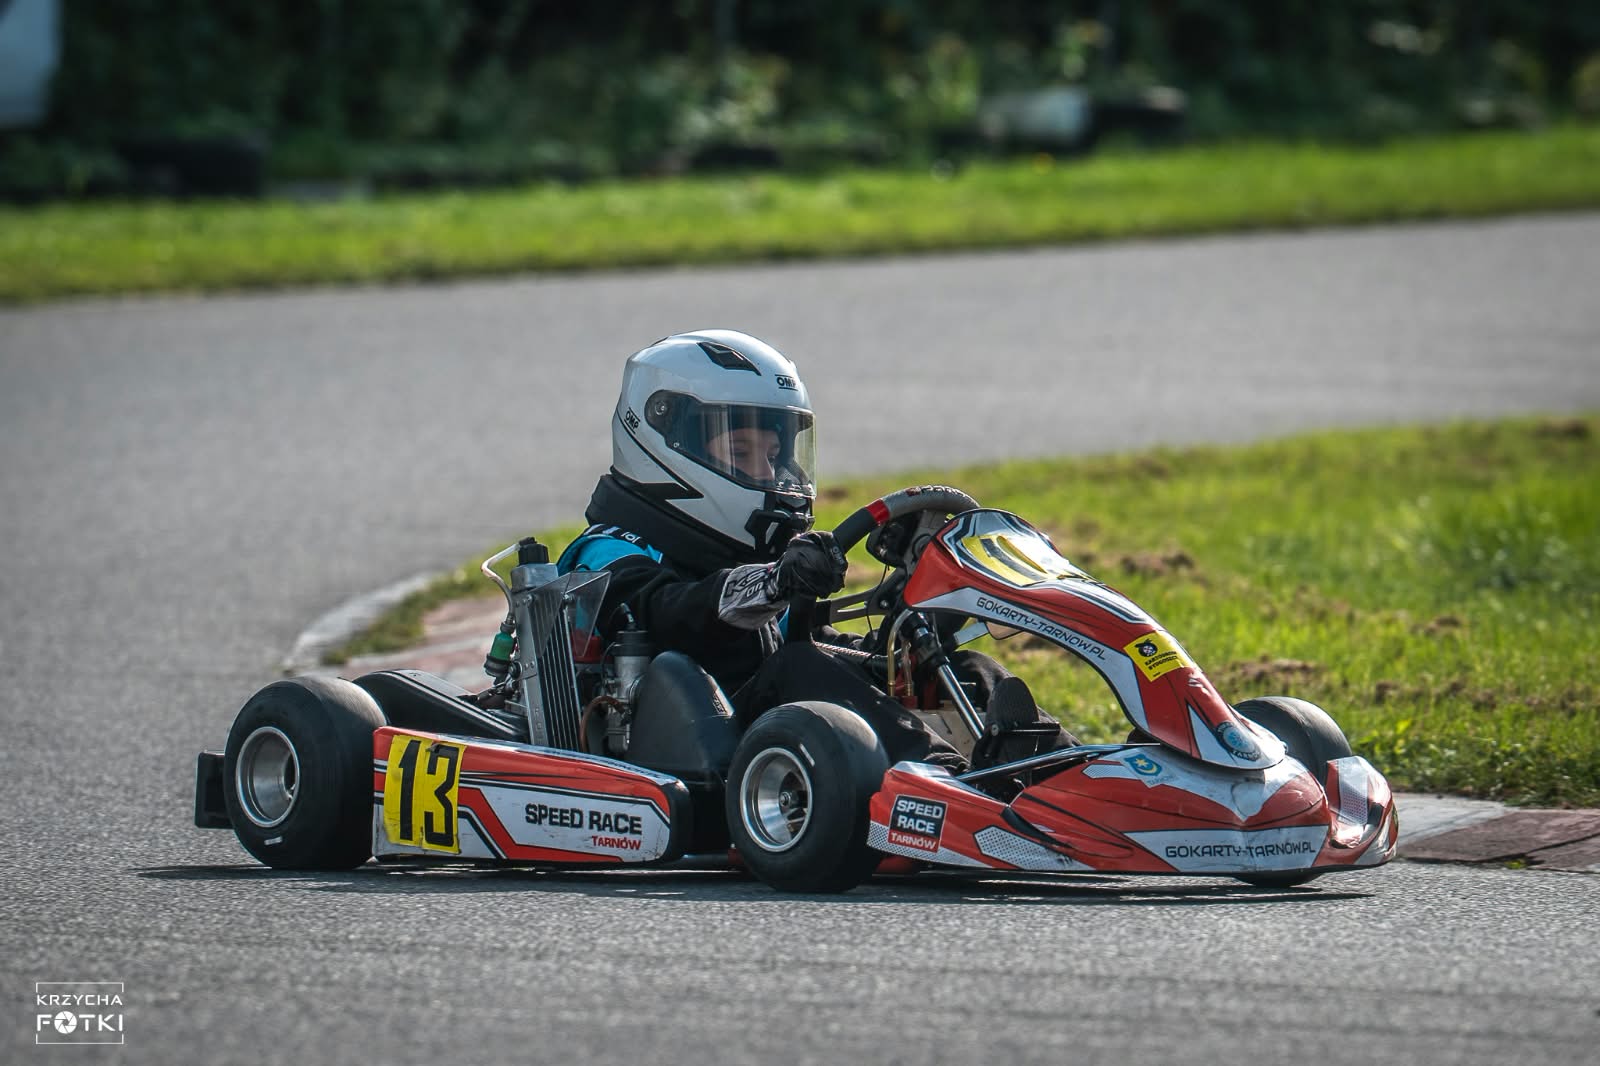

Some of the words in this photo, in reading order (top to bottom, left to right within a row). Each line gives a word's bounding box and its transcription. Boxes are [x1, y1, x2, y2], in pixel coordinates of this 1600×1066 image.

[625, 409, 640, 431] OMP
[976, 597, 1105, 660] GOKARTY-TARNOW.PL
[398, 739, 460, 847] 13
[525, 803, 583, 828] SPEED
[589, 811, 642, 835] RACE
[896, 800, 943, 819] SPEED
[897, 815, 935, 834] RACE
[592, 835, 641, 850] TARNÓW
[890, 832, 936, 850] TARNÓW
[1165, 841, 1316, 858] GOKARTY-TARNOW.PL
